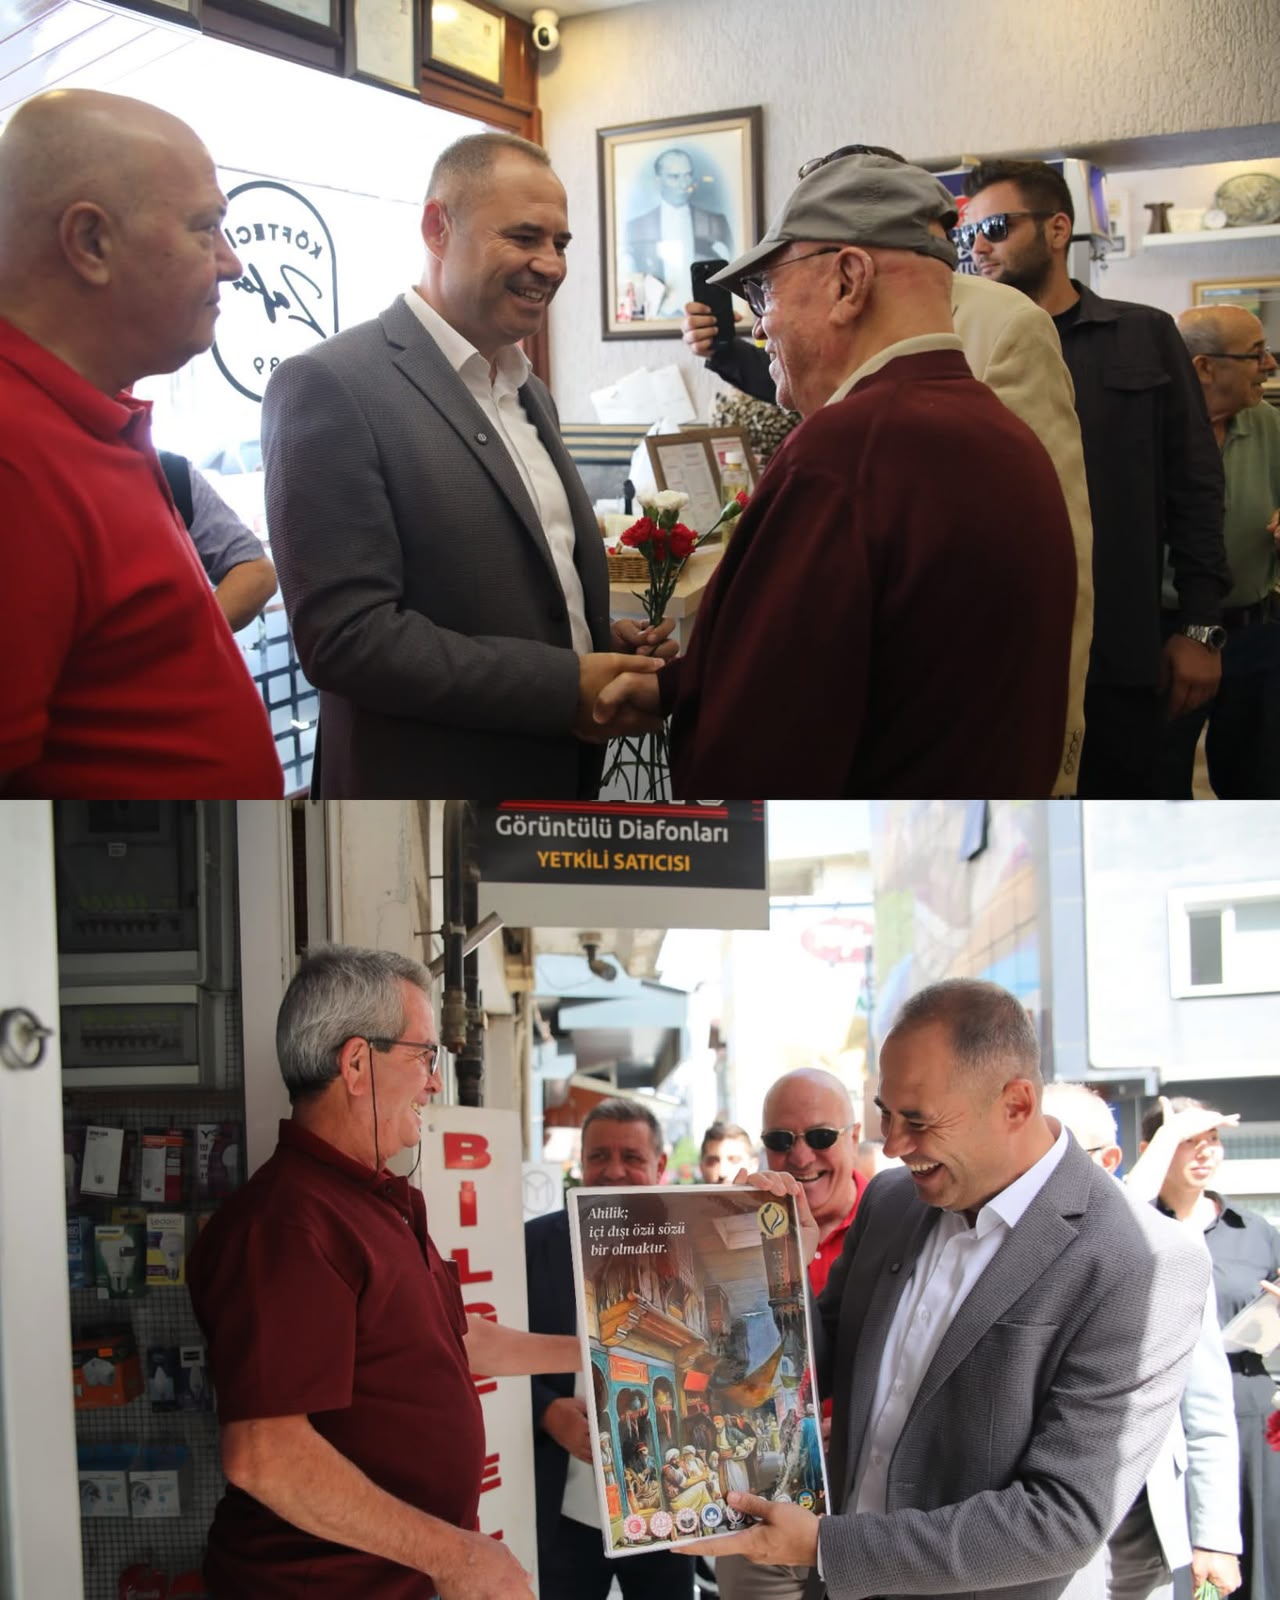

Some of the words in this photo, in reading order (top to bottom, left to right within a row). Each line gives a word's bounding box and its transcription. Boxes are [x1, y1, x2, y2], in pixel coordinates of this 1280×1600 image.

[495, 815, 612, 838] Görüntülü
[618, 819, 729, 843] Diafonları
[537, 849, 609, 869] YETKİLİ
[613, 853, 691, 872] SATICISI
[587, 1206, 629, 1220] Ahilik;
[589, 1225, 604, 1241] içi
[607, 1225, 630, 1240] dışı
[632, 1223, 655, 1236] özü
[657, 1221, 686, 1235] sözü
[591, 1244, 609, 1256] bir
[612, 1242, 668, 1255] olmaktır.
